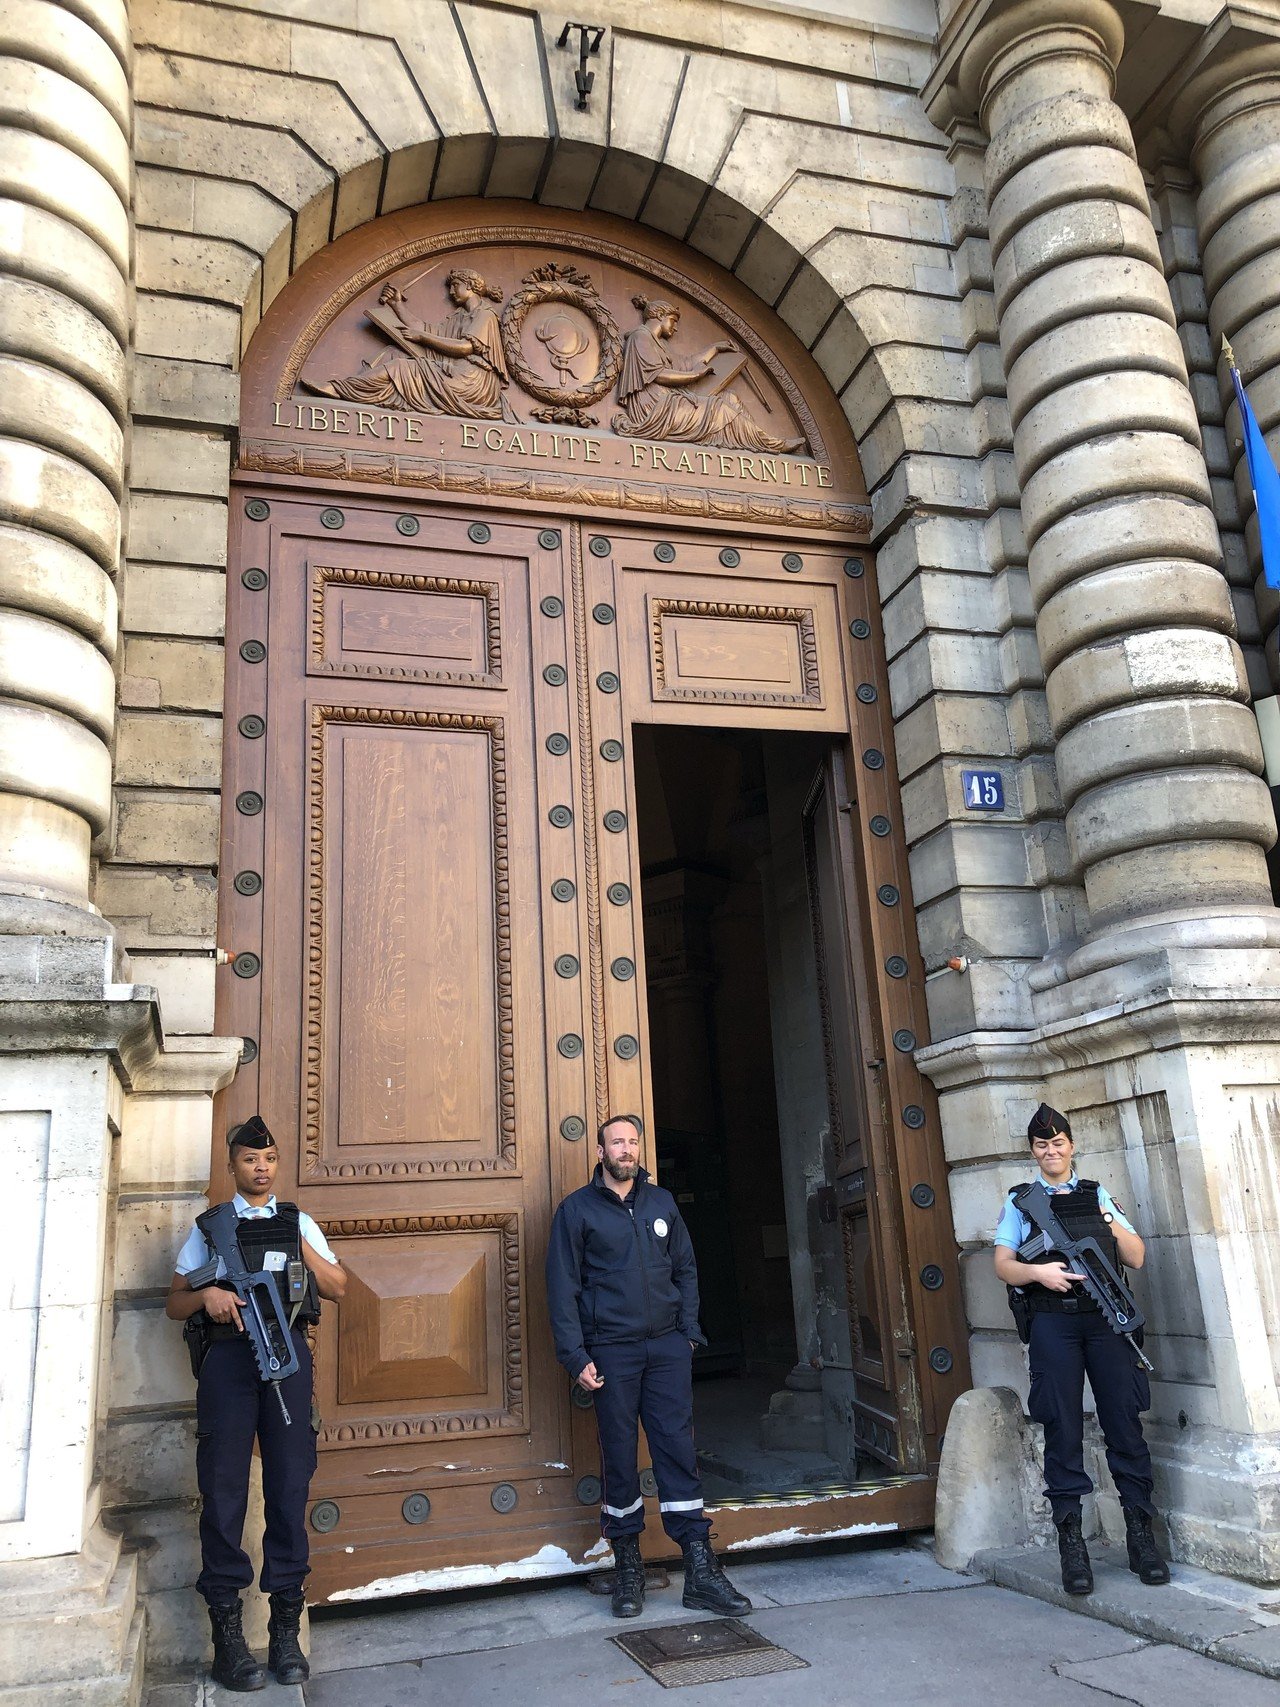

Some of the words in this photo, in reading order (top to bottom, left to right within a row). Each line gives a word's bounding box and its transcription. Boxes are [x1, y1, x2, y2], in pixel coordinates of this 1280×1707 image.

[272, 402, 424, 442] LIBERTE
[460, 424, 602, 463] EGALITE
[630, 443, 834, 488] FRATERNITE
[970, 775, 998, 805] 15
